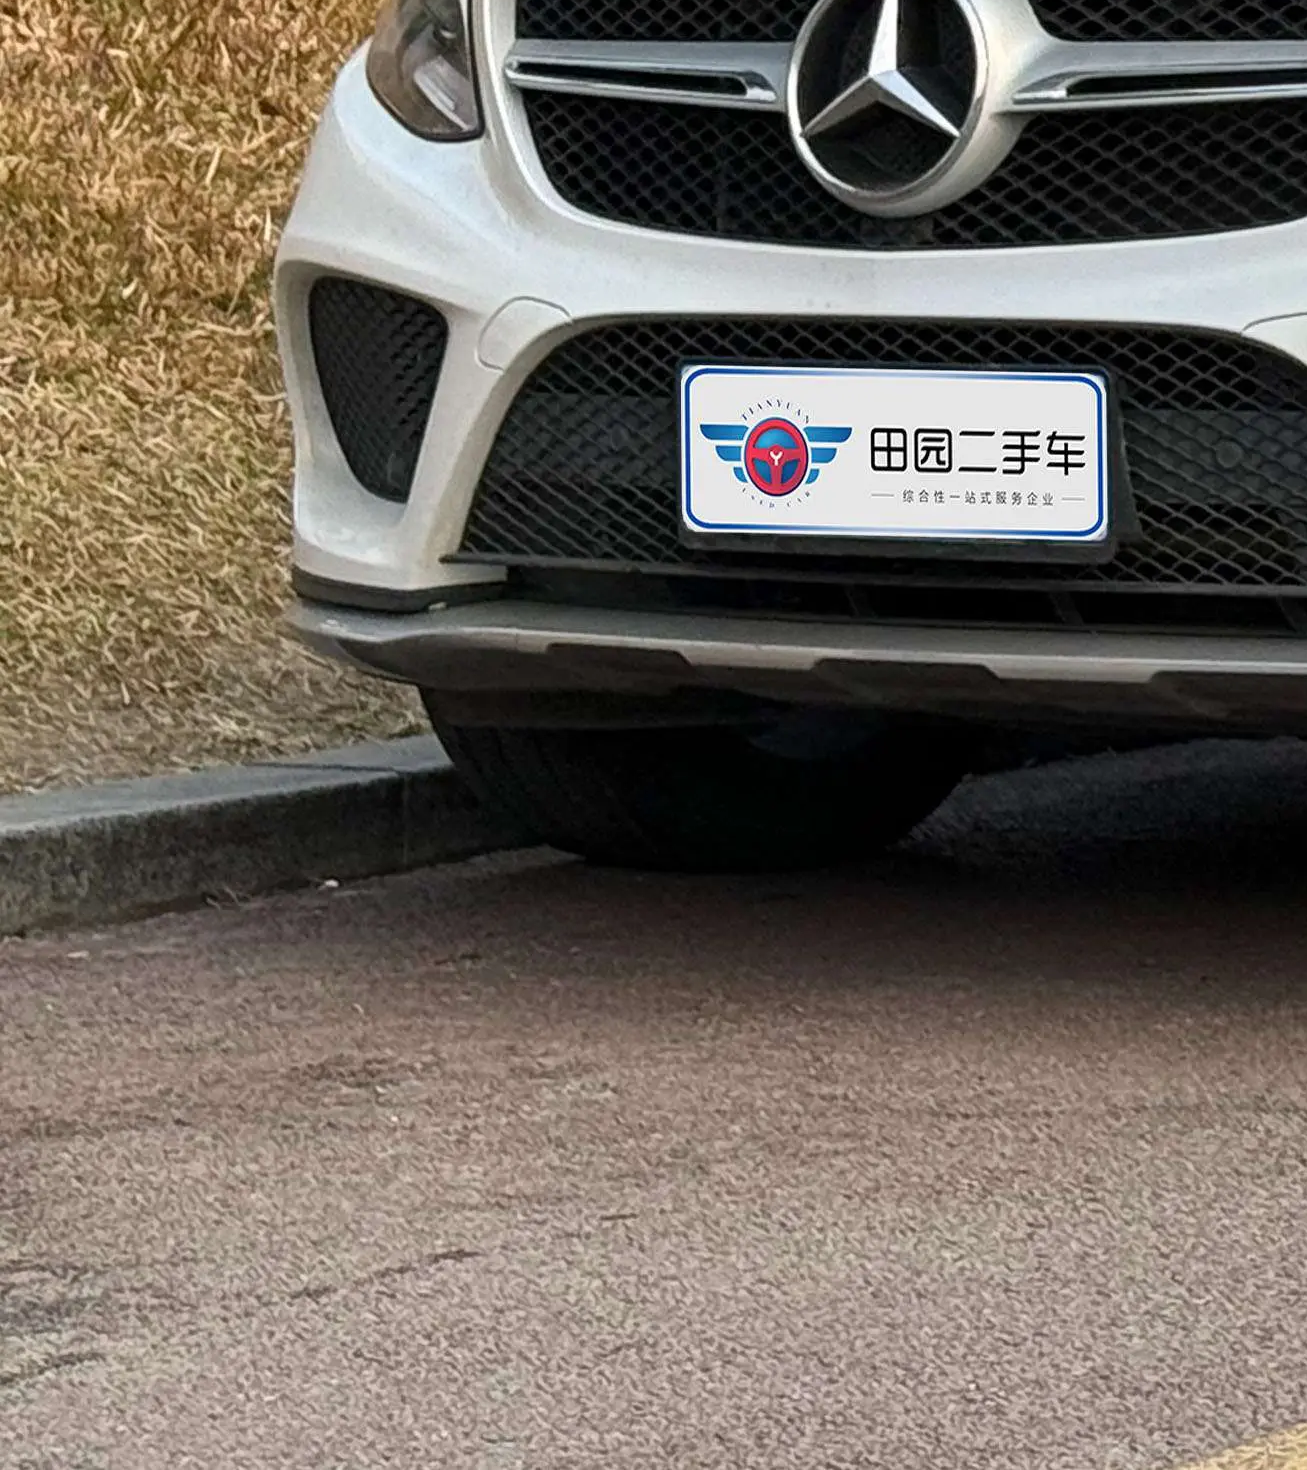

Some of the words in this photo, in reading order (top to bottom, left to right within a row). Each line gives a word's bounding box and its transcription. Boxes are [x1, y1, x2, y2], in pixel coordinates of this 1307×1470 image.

[769, 450, 783, 466] Y
[871, 428, 1085, 476] 田园二手车
[902, 489, 1054, 507] 综合性一站式服务企业
